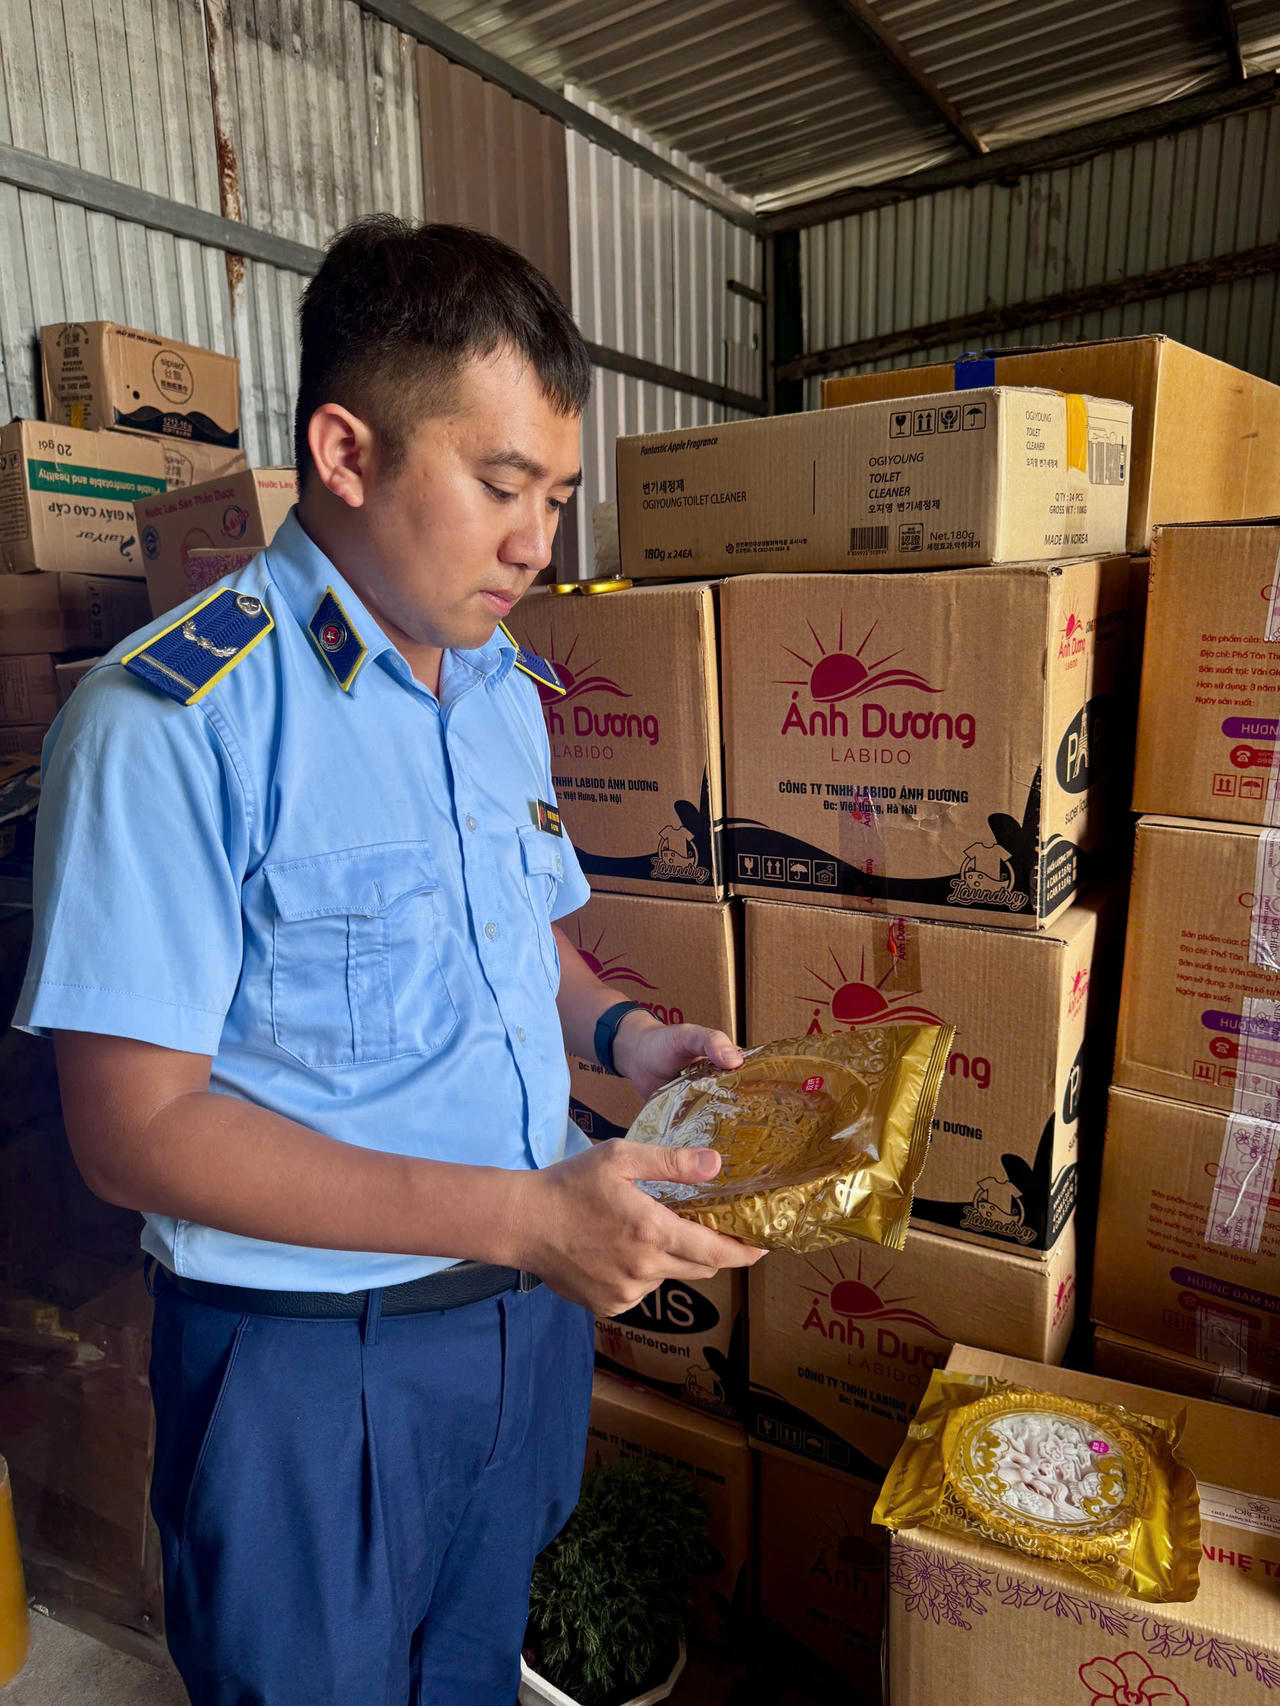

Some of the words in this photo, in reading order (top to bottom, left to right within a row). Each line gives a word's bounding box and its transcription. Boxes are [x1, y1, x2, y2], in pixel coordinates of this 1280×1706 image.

[1025, 410, 1052, 422] OGIYOUNG
[1026, 427, 1041, 437] TOILET
[38, 440, 55, 450] gói
[57, 444, 72, 456] 20
[640, 444, 667, 456] Fantastic
[668, 440, 686, 453] Apple
[686, 436, 718, 450] Fragrance
[1026, 441, 1045, 451] CLEANER
[868, 452, 925, 467] OGIYOUNG
[38, 468, 70, 483] healthy
[72, 475, 88, 485] and
[869, 471, 901, 484] TOILET
[642, 478, 685, 495] 변기세정제
[868, 485, 911, 499] CLEANER
[48, 501, 71, 517] CẤP
[642, 497, 682, 511] OGIYOUNG
[683, 493, 709, 507] TOILET
[710, 491, 747, 504] CLEANER
[867, 500, 893, 514] 오지영
[897, 499, 940, 513] 변기세정제
[74, 504, 96, 517] CAO
[99, 510, 124, 523] GIẤY
[1049, 505, 1065, 514] GROSS
[1044, 534, 1063, 545] MADE
[1063, 534, 1070, 545] IN
[1070, 533, 1088, 545] KOREA
[644, 548, 666, 561] 180g
[673, 548, 693, 560] 24EA
[573, 706, 660, 746] Dương
[781, 690, 849, 737] Ánh
[862, 703, 976, 749] Dương
[552, 744, 614, 760] LABIDO
[831, 747, 911, 765] LABIDO
[575, 777, 605, 789] LABIDO
[607, 775, 627, 790] ÁNH
[628, 779, 659, 792] DƯƠNG
[563, 791, 577, 801] Việt
[577, 792, 598, 803] Hưng,
[599, 792, 608, 802] Hà
[609, 793, 622, 804] Nội
[778, 780, 807, 795] CÔNG
[809, 783, 823, 795] TY
[825, 784, 855, 797] TNHH
[856, 785, 896, 799] LABIDO
[899, 784, 924, 801] ÁNH
[927, 788, 969, 804] DƯƠNG
[823, 800, 838, 811] Đc:
[839, 800, 857, 813] Việt
[886, 802, 899, 814] Hà
[901, 802, 917, 816] Nội
[651, 856, 709, 884] Laundry
[948, 879, 1028, 911] Laundry
[943, 1120, 983, 1141] DƯƠNG
[960, 1206, 1038, 1245] Laundry
[801, 1297, 865, 1350] Ánh
[594, 1319, 622, 1337] quid
[625, 1330, 691, 1358] detergent
[848, 1356, 922, 1389] LABIDO
[798, 1366, 825, 1384] CÔNG
[827, 1376, 838, 1388] TY
[841, 1381, 867, 1398] TNHH
[1201, 1543, 1252, 1573] NHẸ
